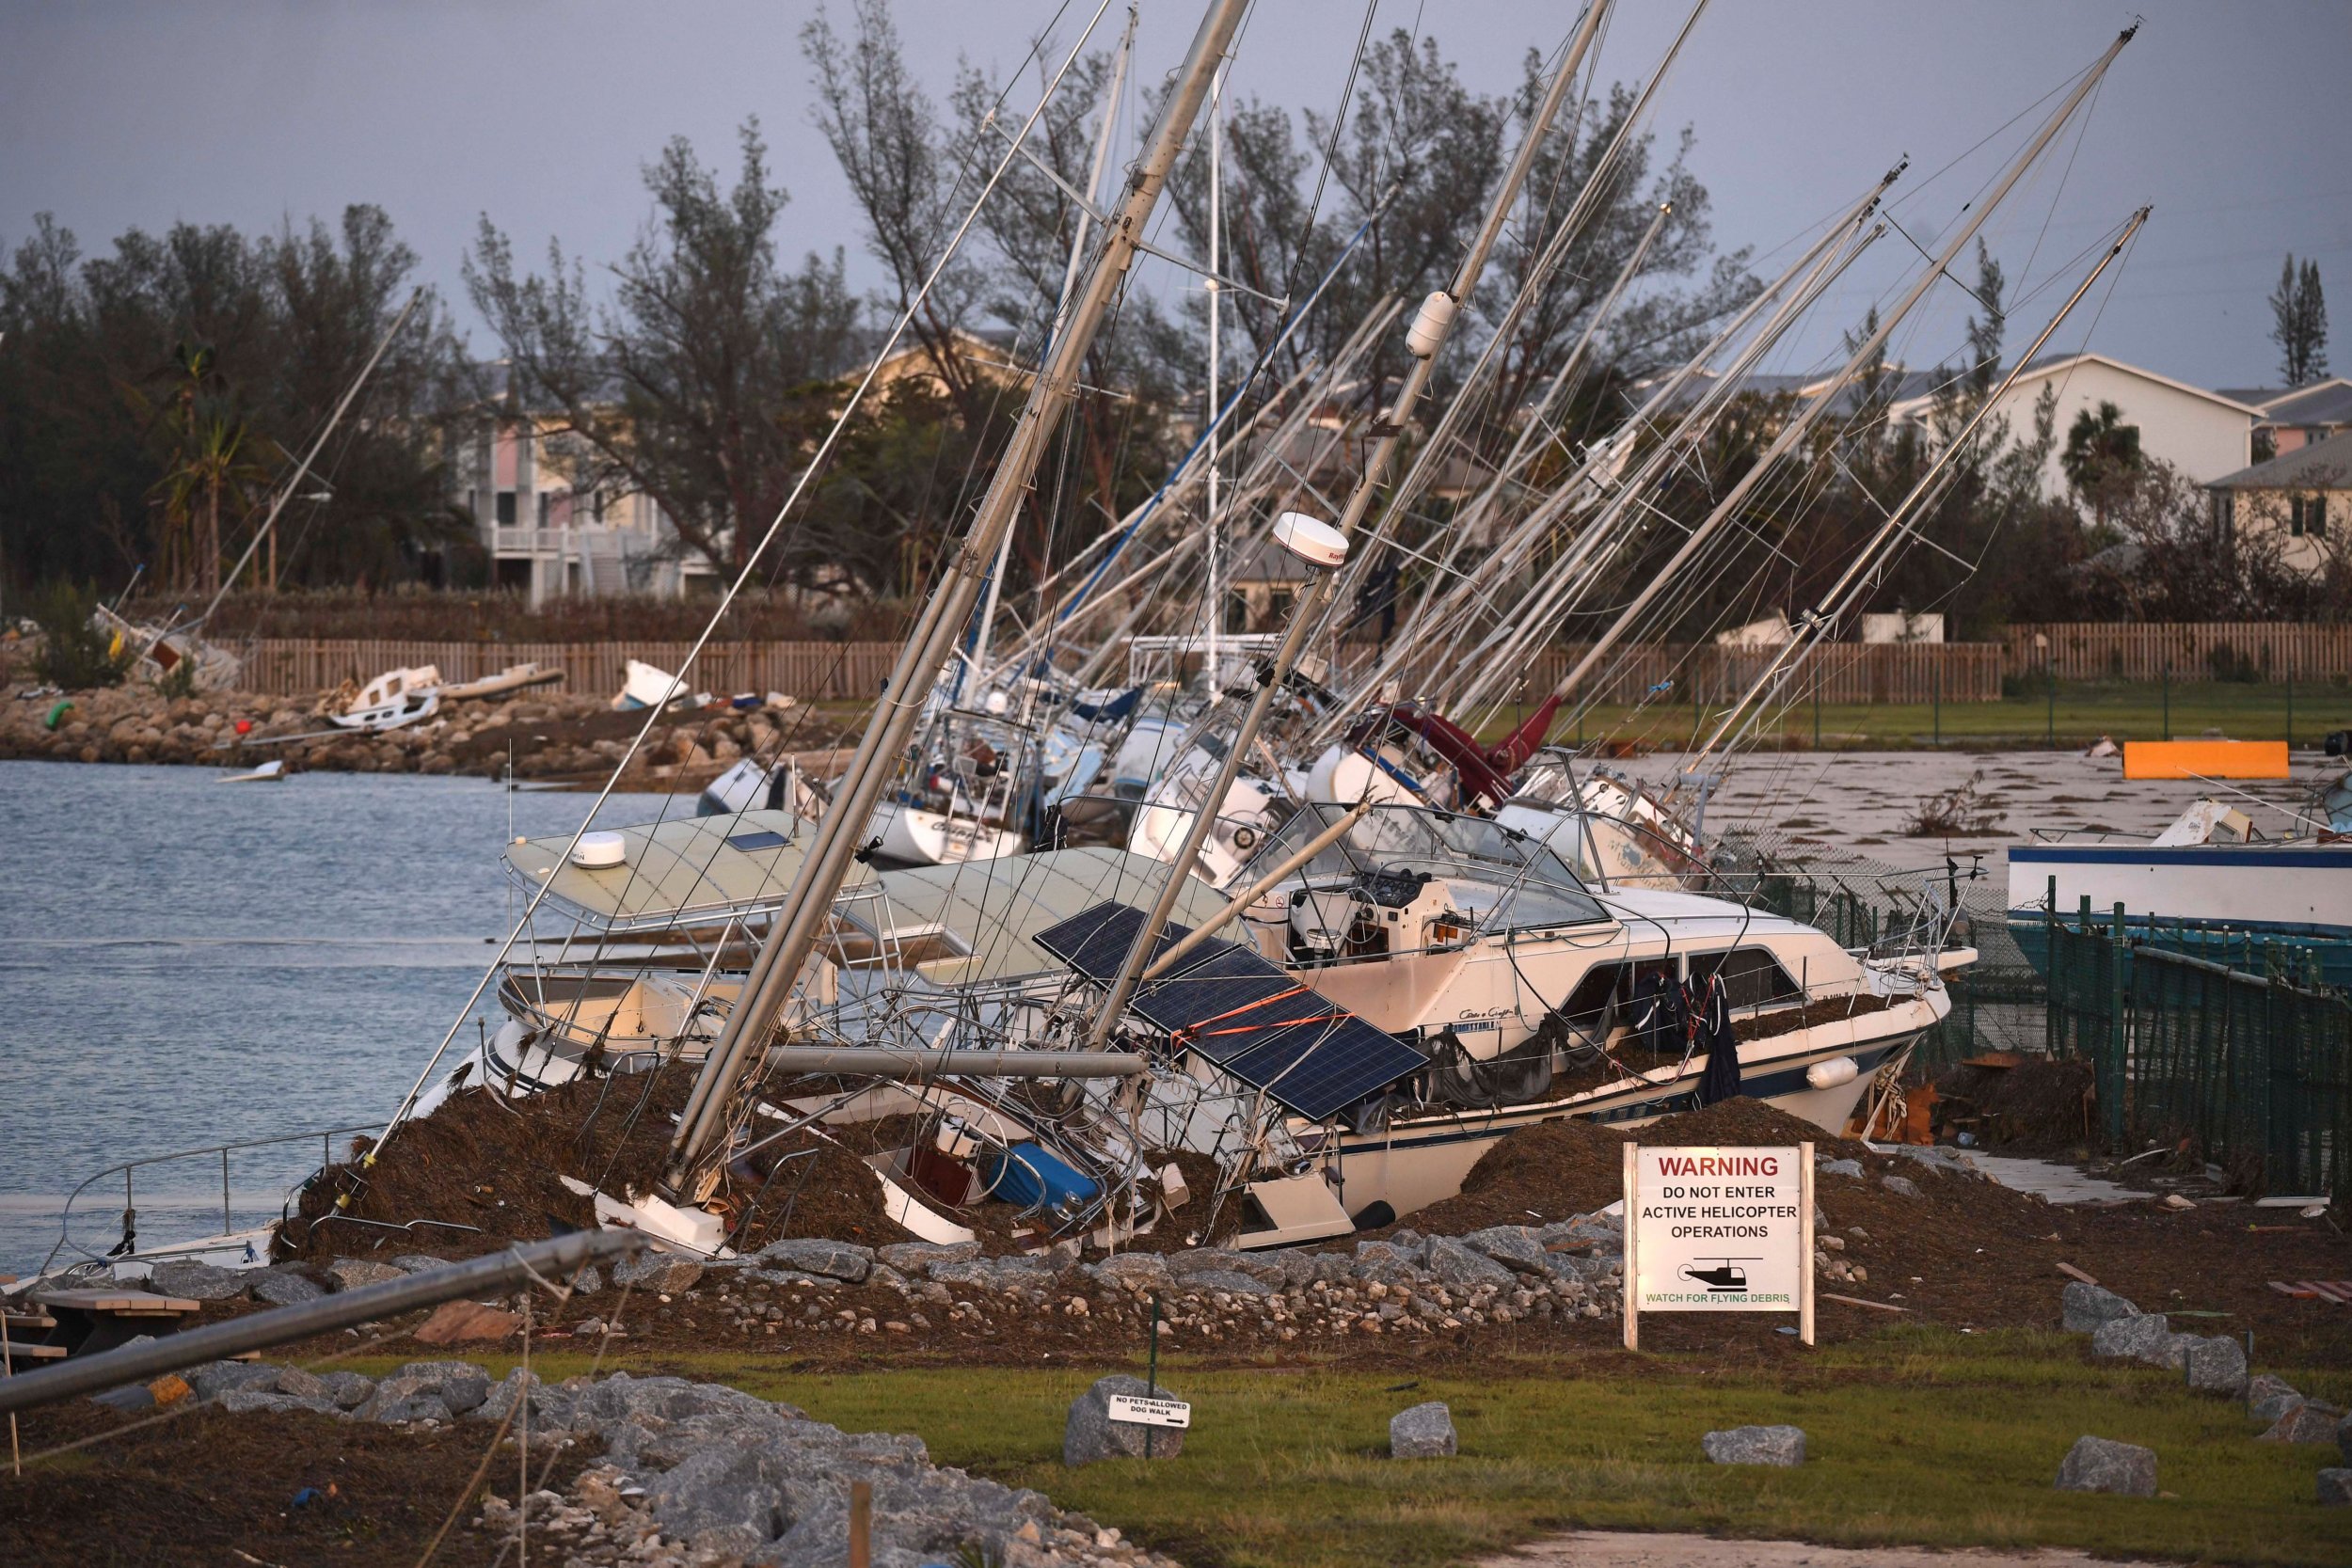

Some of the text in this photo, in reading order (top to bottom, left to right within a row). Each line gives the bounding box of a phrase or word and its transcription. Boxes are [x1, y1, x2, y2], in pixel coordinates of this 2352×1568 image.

[1659, 1157, 1778, 1177] WARNING
[1662, 1186, 1775, 1198] DO NOT ENTER
[1642, 1206, 1797, 1218] ACTIVE HELICOPTER
[1671, 1226, 1769, 1238] OPERATIONS
[1646, 1293, 1789, 1303] WATCH FOR FLYING DEBRIS
[1129, 1398, 1149, 1406] PETS
[1151, 1401, 1187, 1410] ALLOWED
[1149, 1407, 1171, 1416] WALK
